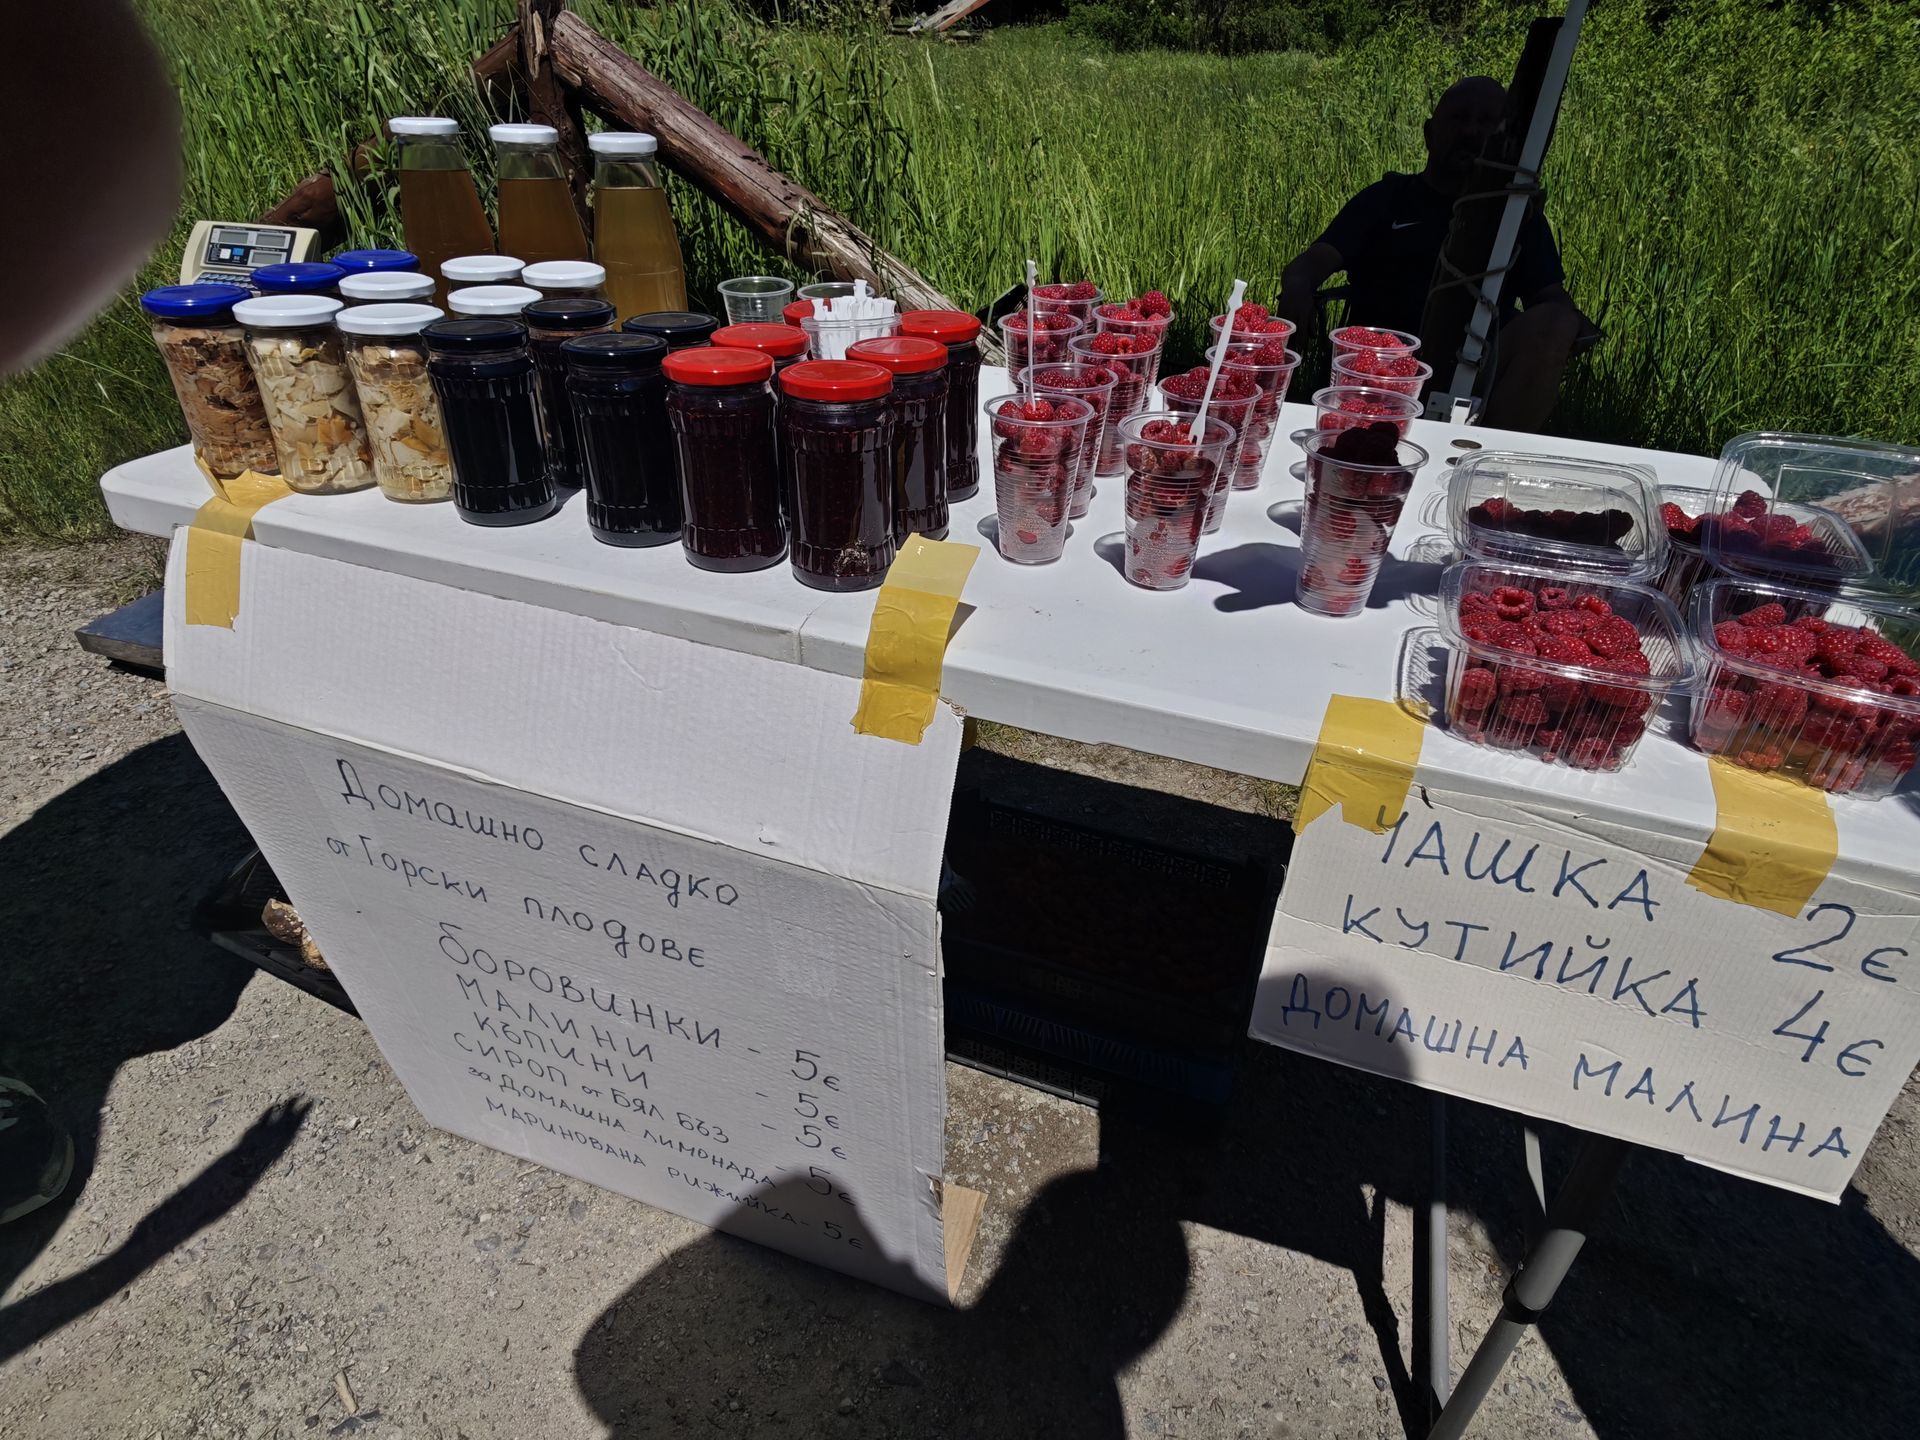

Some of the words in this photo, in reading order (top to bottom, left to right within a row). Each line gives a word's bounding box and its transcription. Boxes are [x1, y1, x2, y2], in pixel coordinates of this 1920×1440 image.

[1376, 804, 1660, 922] ЧАШКА
[1342, 894, 1708, 1029] КУТИЙКА
[456, 973, 653, 1063] МАЛИНИ
[473, 1011, 649, 1090] КЪПИНИ
[1281, 973, 1529, 1070] ДОМАШНА
[1573, 1053, 1851, 1158] МАЛИНА
[453, 1032, 568, 1087] СИРОП
[611, 1087, 665, 1121] БЯЛ
[485, 1096, 646, 1168] МАРИНОВАНА
[499, 1073, 626, 1132] ДОМАШНА
[643, 1129, 777, 1189] ЛИМОНАДА
